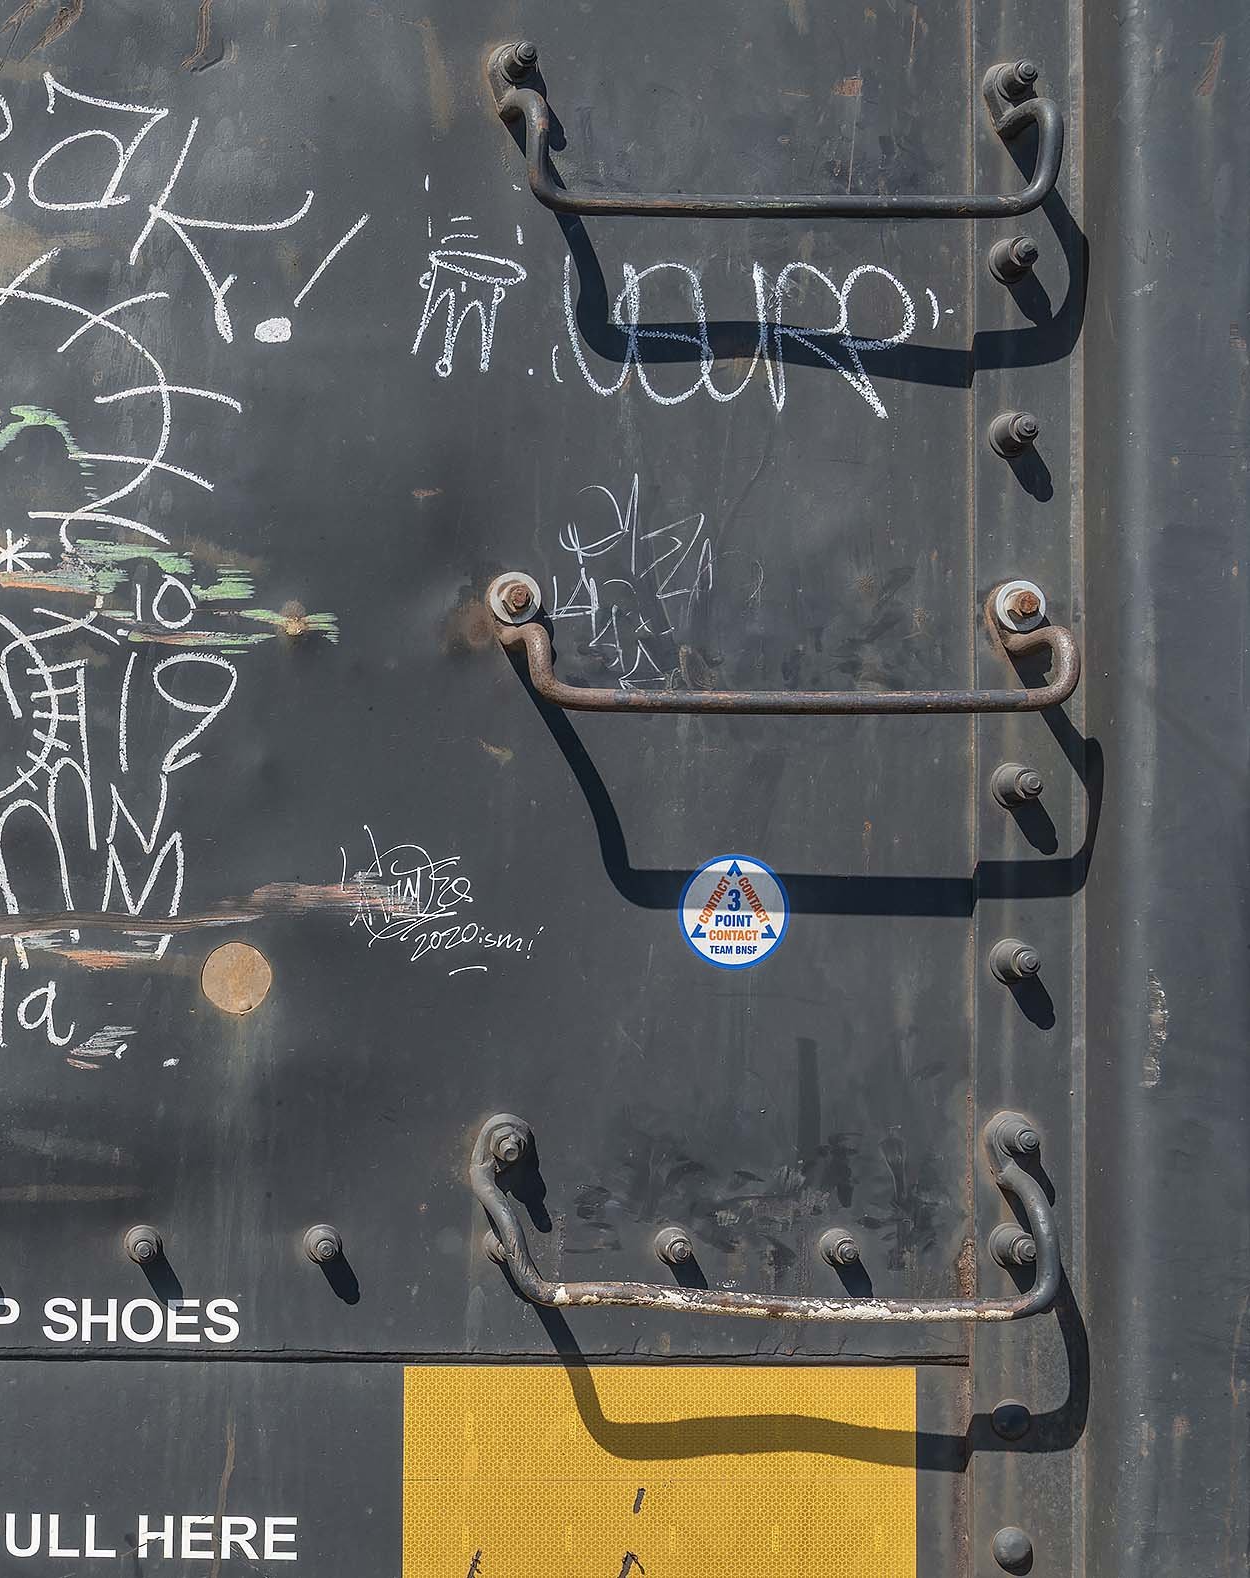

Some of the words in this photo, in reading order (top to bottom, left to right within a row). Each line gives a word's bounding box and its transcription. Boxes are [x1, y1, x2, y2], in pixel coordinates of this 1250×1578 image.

[698, 876, 731, 924] CONTACT
[727, 888, 741, 912] 3
[738, 876, 770, 924] CONTACT
[709, 929, 759, 941] CONTACT
[714, 914, 753, 927] POINT
[709, 945, 733, 955] TEAM
[735, 945, 758, 955] BNSF
[41, 1296, 241, 1344] SHOES
[138, 1514, 299, 1562] HERE
